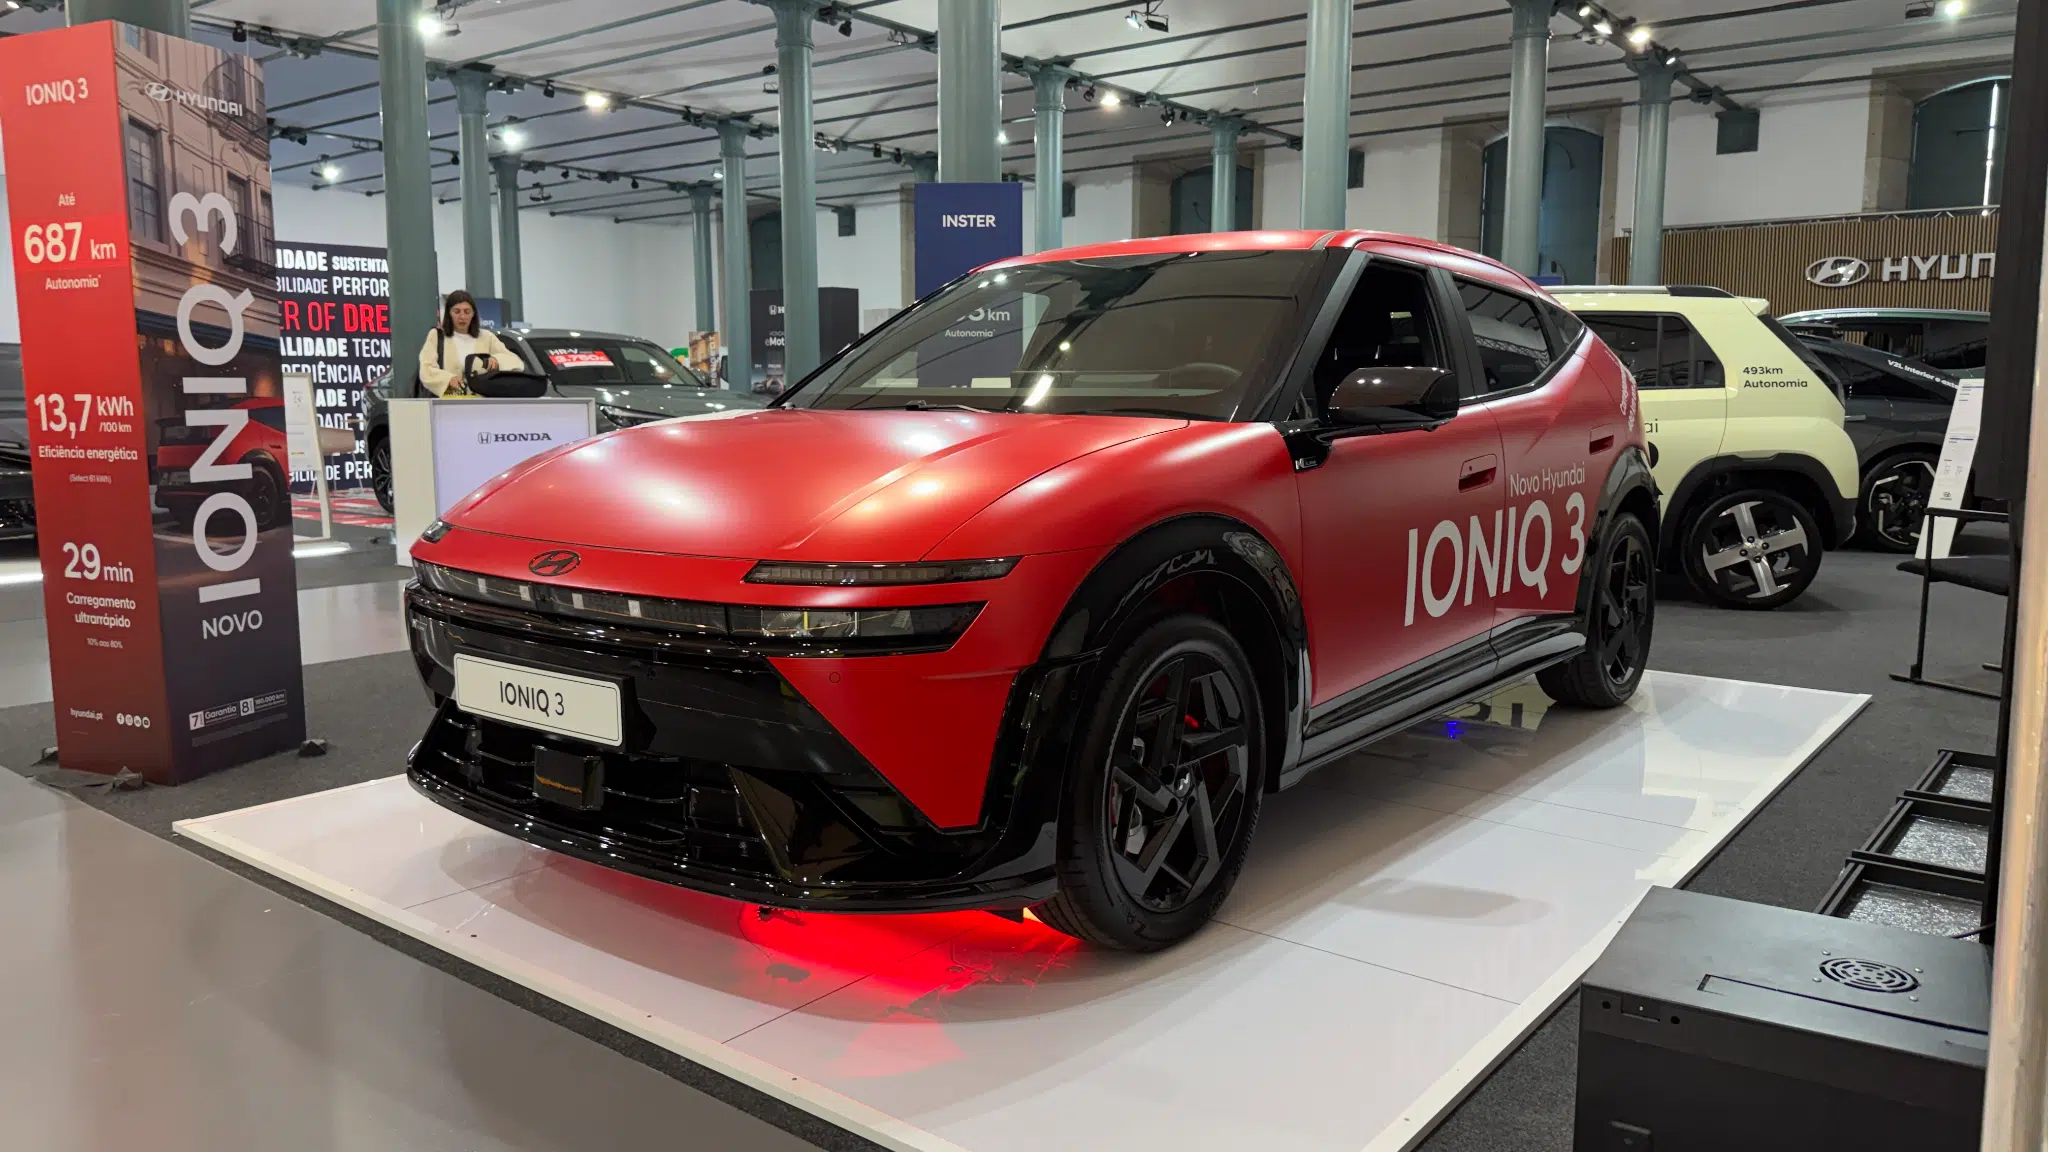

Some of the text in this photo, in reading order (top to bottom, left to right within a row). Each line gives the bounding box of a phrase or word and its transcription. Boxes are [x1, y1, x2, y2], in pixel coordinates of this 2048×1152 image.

[26, 77, 88, 106] IONIQ 3
[176, 89, 243, 117] HYUNDAI
[58, 192, 76, 206] Até
[942, 214, 996, 228] INSTER
[24, 222, 116, 263] 687 km
[1882, 252, 1996, 282] HYUN
[332, 276, 390, 297] PERFOR
[307, 301, 336, 331] OF
[987, 309, 1010, 321] km
[1743, 366, 1783, 375] 493km
[1887, 359, 1903, 370] V2L
[1904, 365, 1935, 380] interior
[1744, 379, 1808, 388] Autonomia
[168, 192, 261, 603] IONIQ 3
[34, 393, 134, 439] 13,7 kWh
[99, 422, 132, 433] /100 km
[494, 432, 552, 442] HONDA
[38, 445, 138, 462] Eficiência energética
[1510, 461, 1585, 497] Novo Hyundai
[62, 542, 134, 583] 29 min
[1404, 492, 1585, 627] IONIQ 3
[66, 592, 136, 610] Carregamento
[75, 611, 131, 628] ultrarrápido
[202, 609, 263, 640] NOVO
[242, 701, 250, 714] 8
[500, 681, 565, 717] IONIQ 3
[191, 714, 200, 728] 7
[204, 705, 237, 719] Garantia
